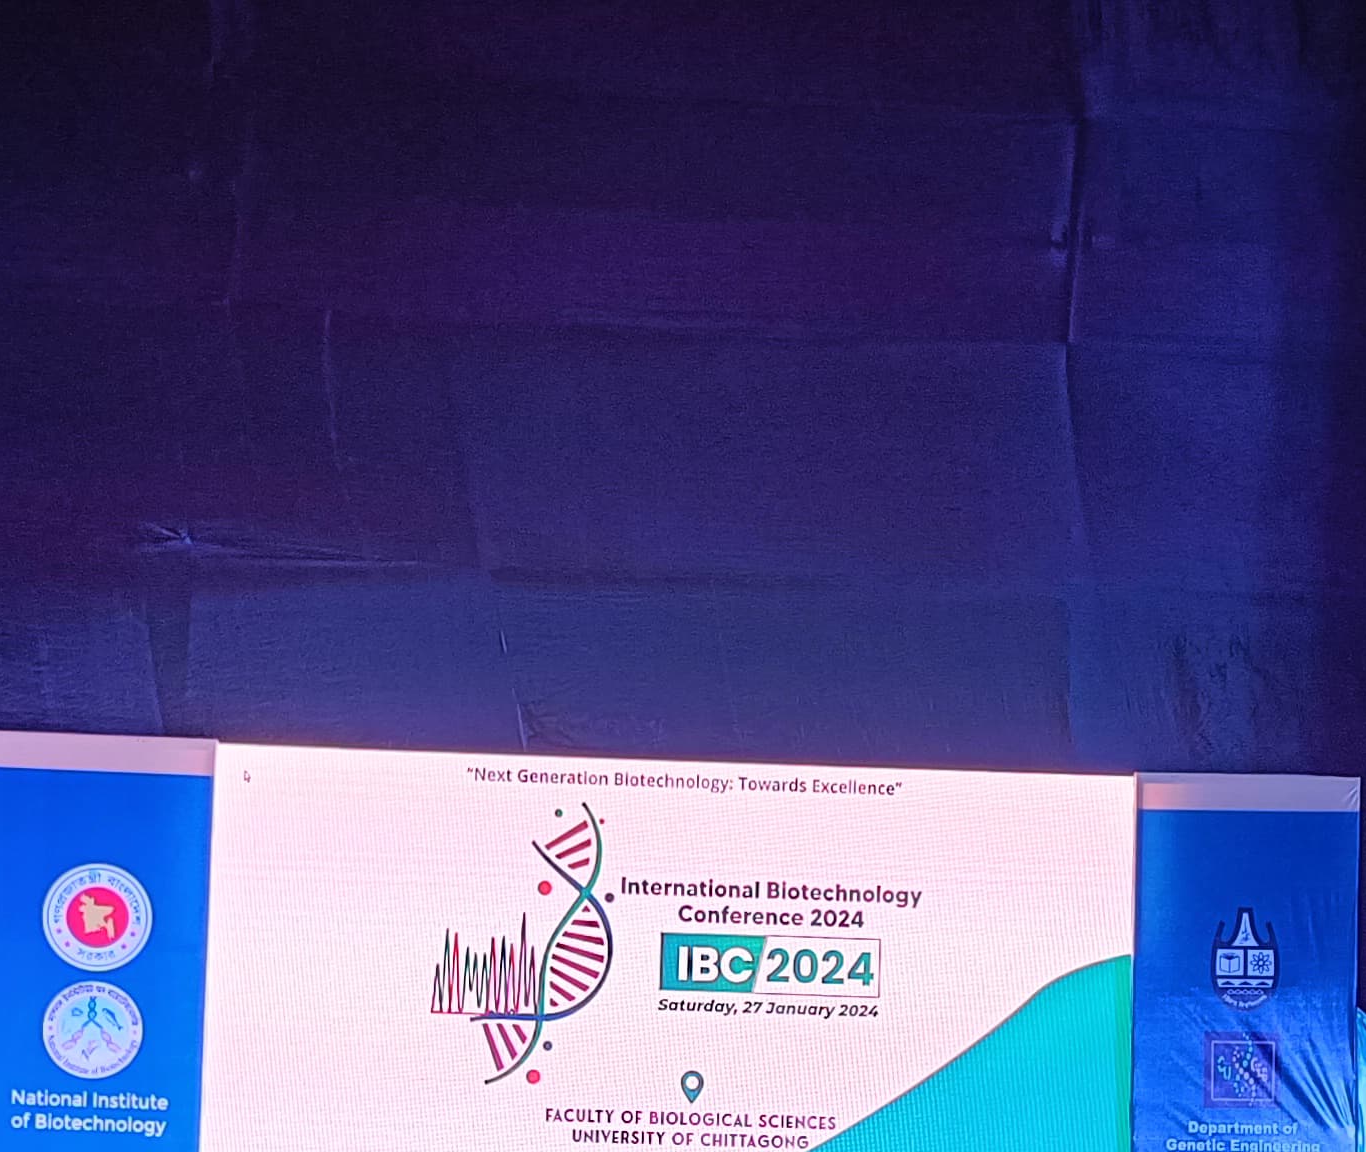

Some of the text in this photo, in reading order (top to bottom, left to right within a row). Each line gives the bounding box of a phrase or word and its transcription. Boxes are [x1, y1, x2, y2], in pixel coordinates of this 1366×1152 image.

[517, 769, 608, 787] Generation
[614, 772, 734, 794] Biotechnology:
[738, 776, 807, 793] Towards
[621, 876, 923, 908] International Biotechnology
[678, 904, 865, 928] Conference 2024
[677, 945, 875, 987] IBC 2024
[658, 998, 879, 1020] Saturday, 27 January 2024
[10, 1088, 170, 1111] National Institute
[10, 1112, 168, 1138] of Biotechnology
[545, 1108, 837, 1130] FACULTY OF BIOLOGICAL SCIENCES
[1188, 1120, 1299, 1137] Department of
[572, 1128, 810, 1150] UNIVERSITY OF CHITTAGONG
[1166, 1138, 1226, 1152] Genetic
